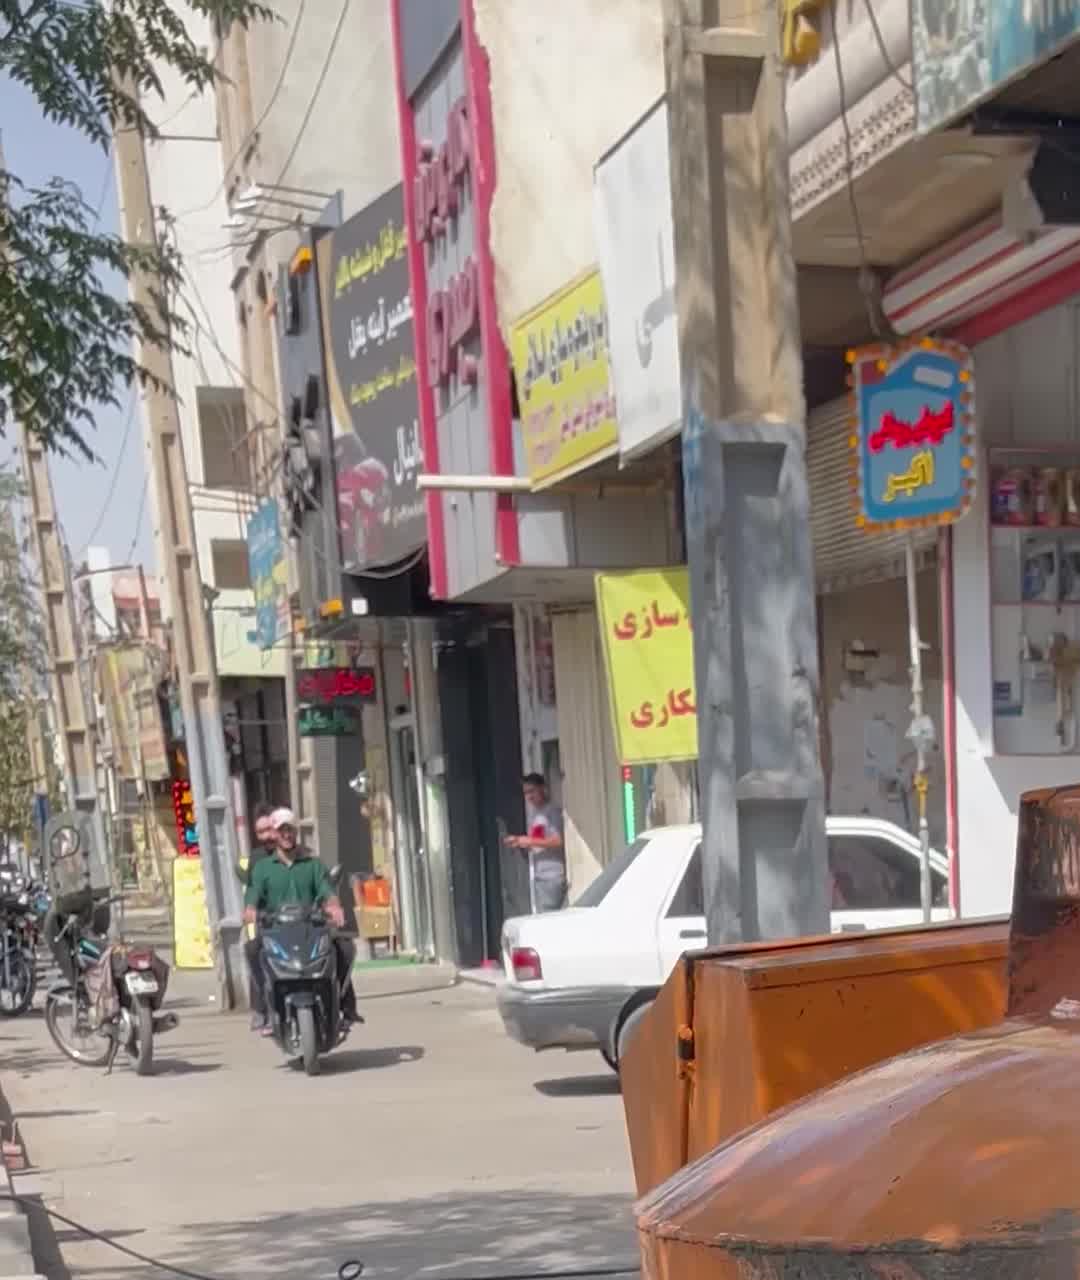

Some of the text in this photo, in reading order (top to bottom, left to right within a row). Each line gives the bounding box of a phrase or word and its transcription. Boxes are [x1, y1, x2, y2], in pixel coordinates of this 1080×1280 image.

[882, 448, 934, 503] اکبر
[614, 600, 680, 641] سازی
[631, 687, 697, 728] کاری
